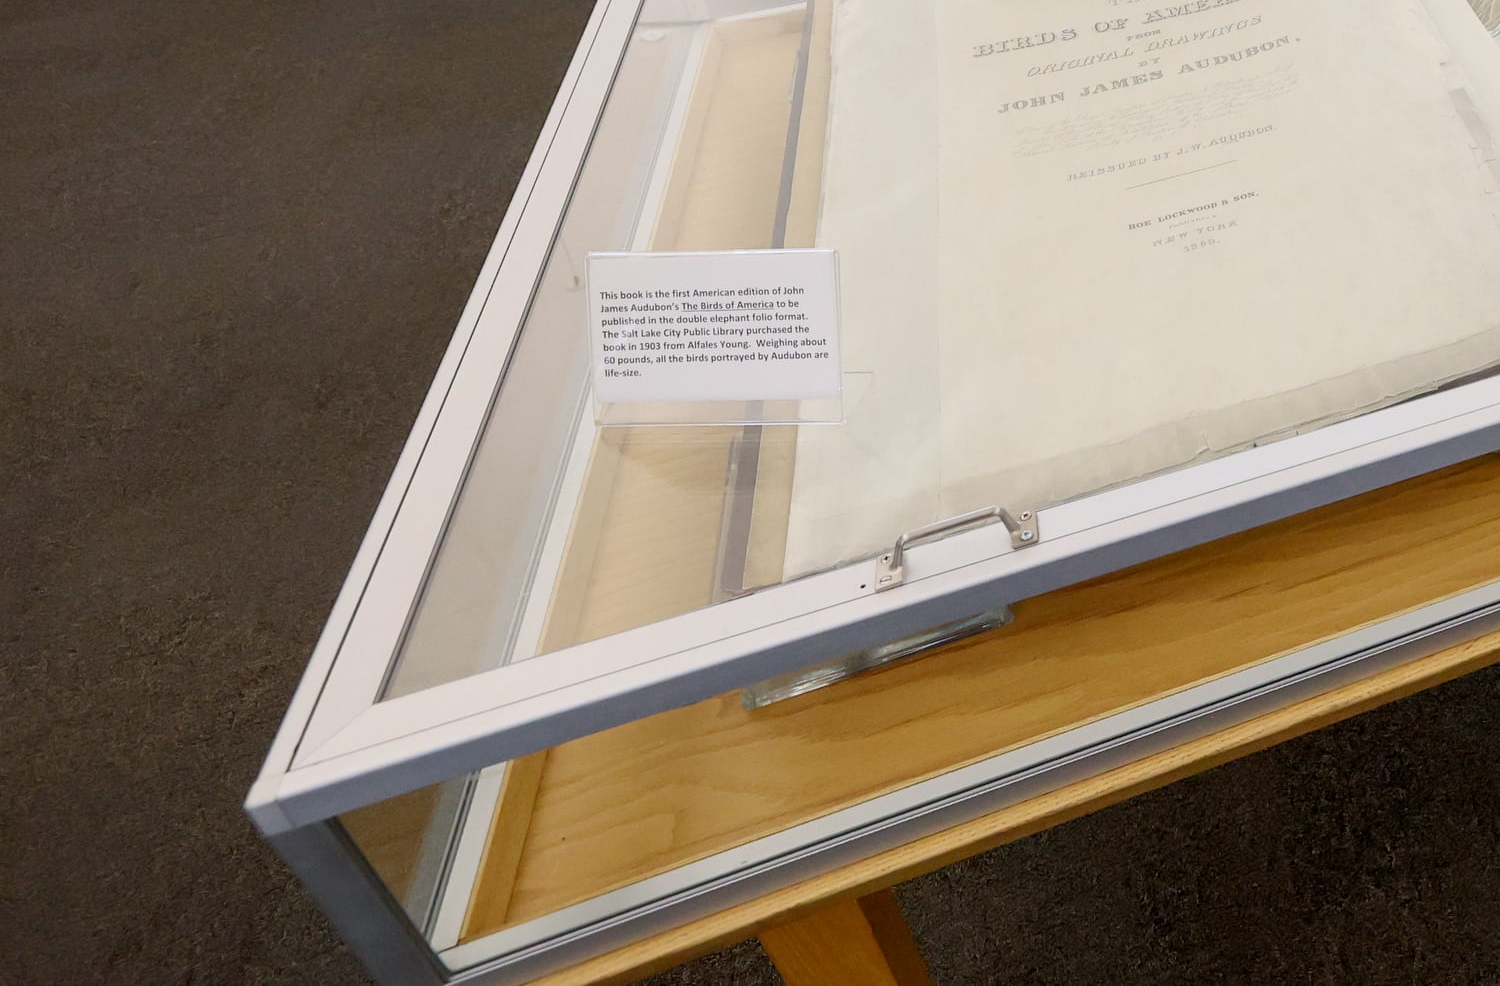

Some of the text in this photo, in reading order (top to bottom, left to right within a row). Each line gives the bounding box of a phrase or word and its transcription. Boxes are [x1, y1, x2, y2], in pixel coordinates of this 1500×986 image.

[973, 28, 1077, 58] BIRDS
[1094, 17, 1129, 34] OF
[1126, 29, 1161, 42] FROM
[1026, 14, 1263, 78] ORIGINAL DRAWINGS
[997, 35, 1302, 114] JOHN JAMES AUDUBON.
[1128, 220, 1152, 231] ROE
[1157, 202, 1218, 223] LOCKWOOD
[1233, 191, 1260, 203] SON.
[1152, 231, 1189, 248] NEW
[620, 291, 643, 299] book
[646, 290, 652, 298] is
[655, 290, 669, 298] the
[693, 288, 735, 297] American
[738, 288, 769, 296] edition
[772, 287, 780, 295] of
[601, 305, 628, 313] James
[682, 302, 698, 311] The
[701, 301, 723, 310] Birds
[725, 301, 734, 309] of
[737, 301, 774, 309] America
[776, 300, 786, 308] to
[602, 317, 646, 327] published
[660, 316, 674, 324] the
[677, 315, 707, 323] double
[710, 314, 750, 324] elephant
[752, 313, 772, 321] folio
[775, 313, 808, 321] format.
[622, 330, 638, 338] Salt
[664, 329, 680, 338] City
[683, 328, 710, 336] Public
[713, 328, 743, 336] Library
[746, 326, 792, 336] purchased
[640, 342, 660, 350] 1903
[664, 342, 685, 350] from
[688, 341, 718, 349] Alfales
[720, 340, 751, 349] Young.
[756, 339, 798, 348] Weighing
[801, 338, 826, 346] about
[604, 356, 615, 364] 60
[618, 356, 653, 365] pounds,
[656, 355, 666, 363] all
[686, 354, 708, 362] birds
[711, 353, 755, 363] portrayed
[758, 352, 768, 361] by
[771, 352, 812, 360] Audubon
[605, 369, 642, 377] life-size.
